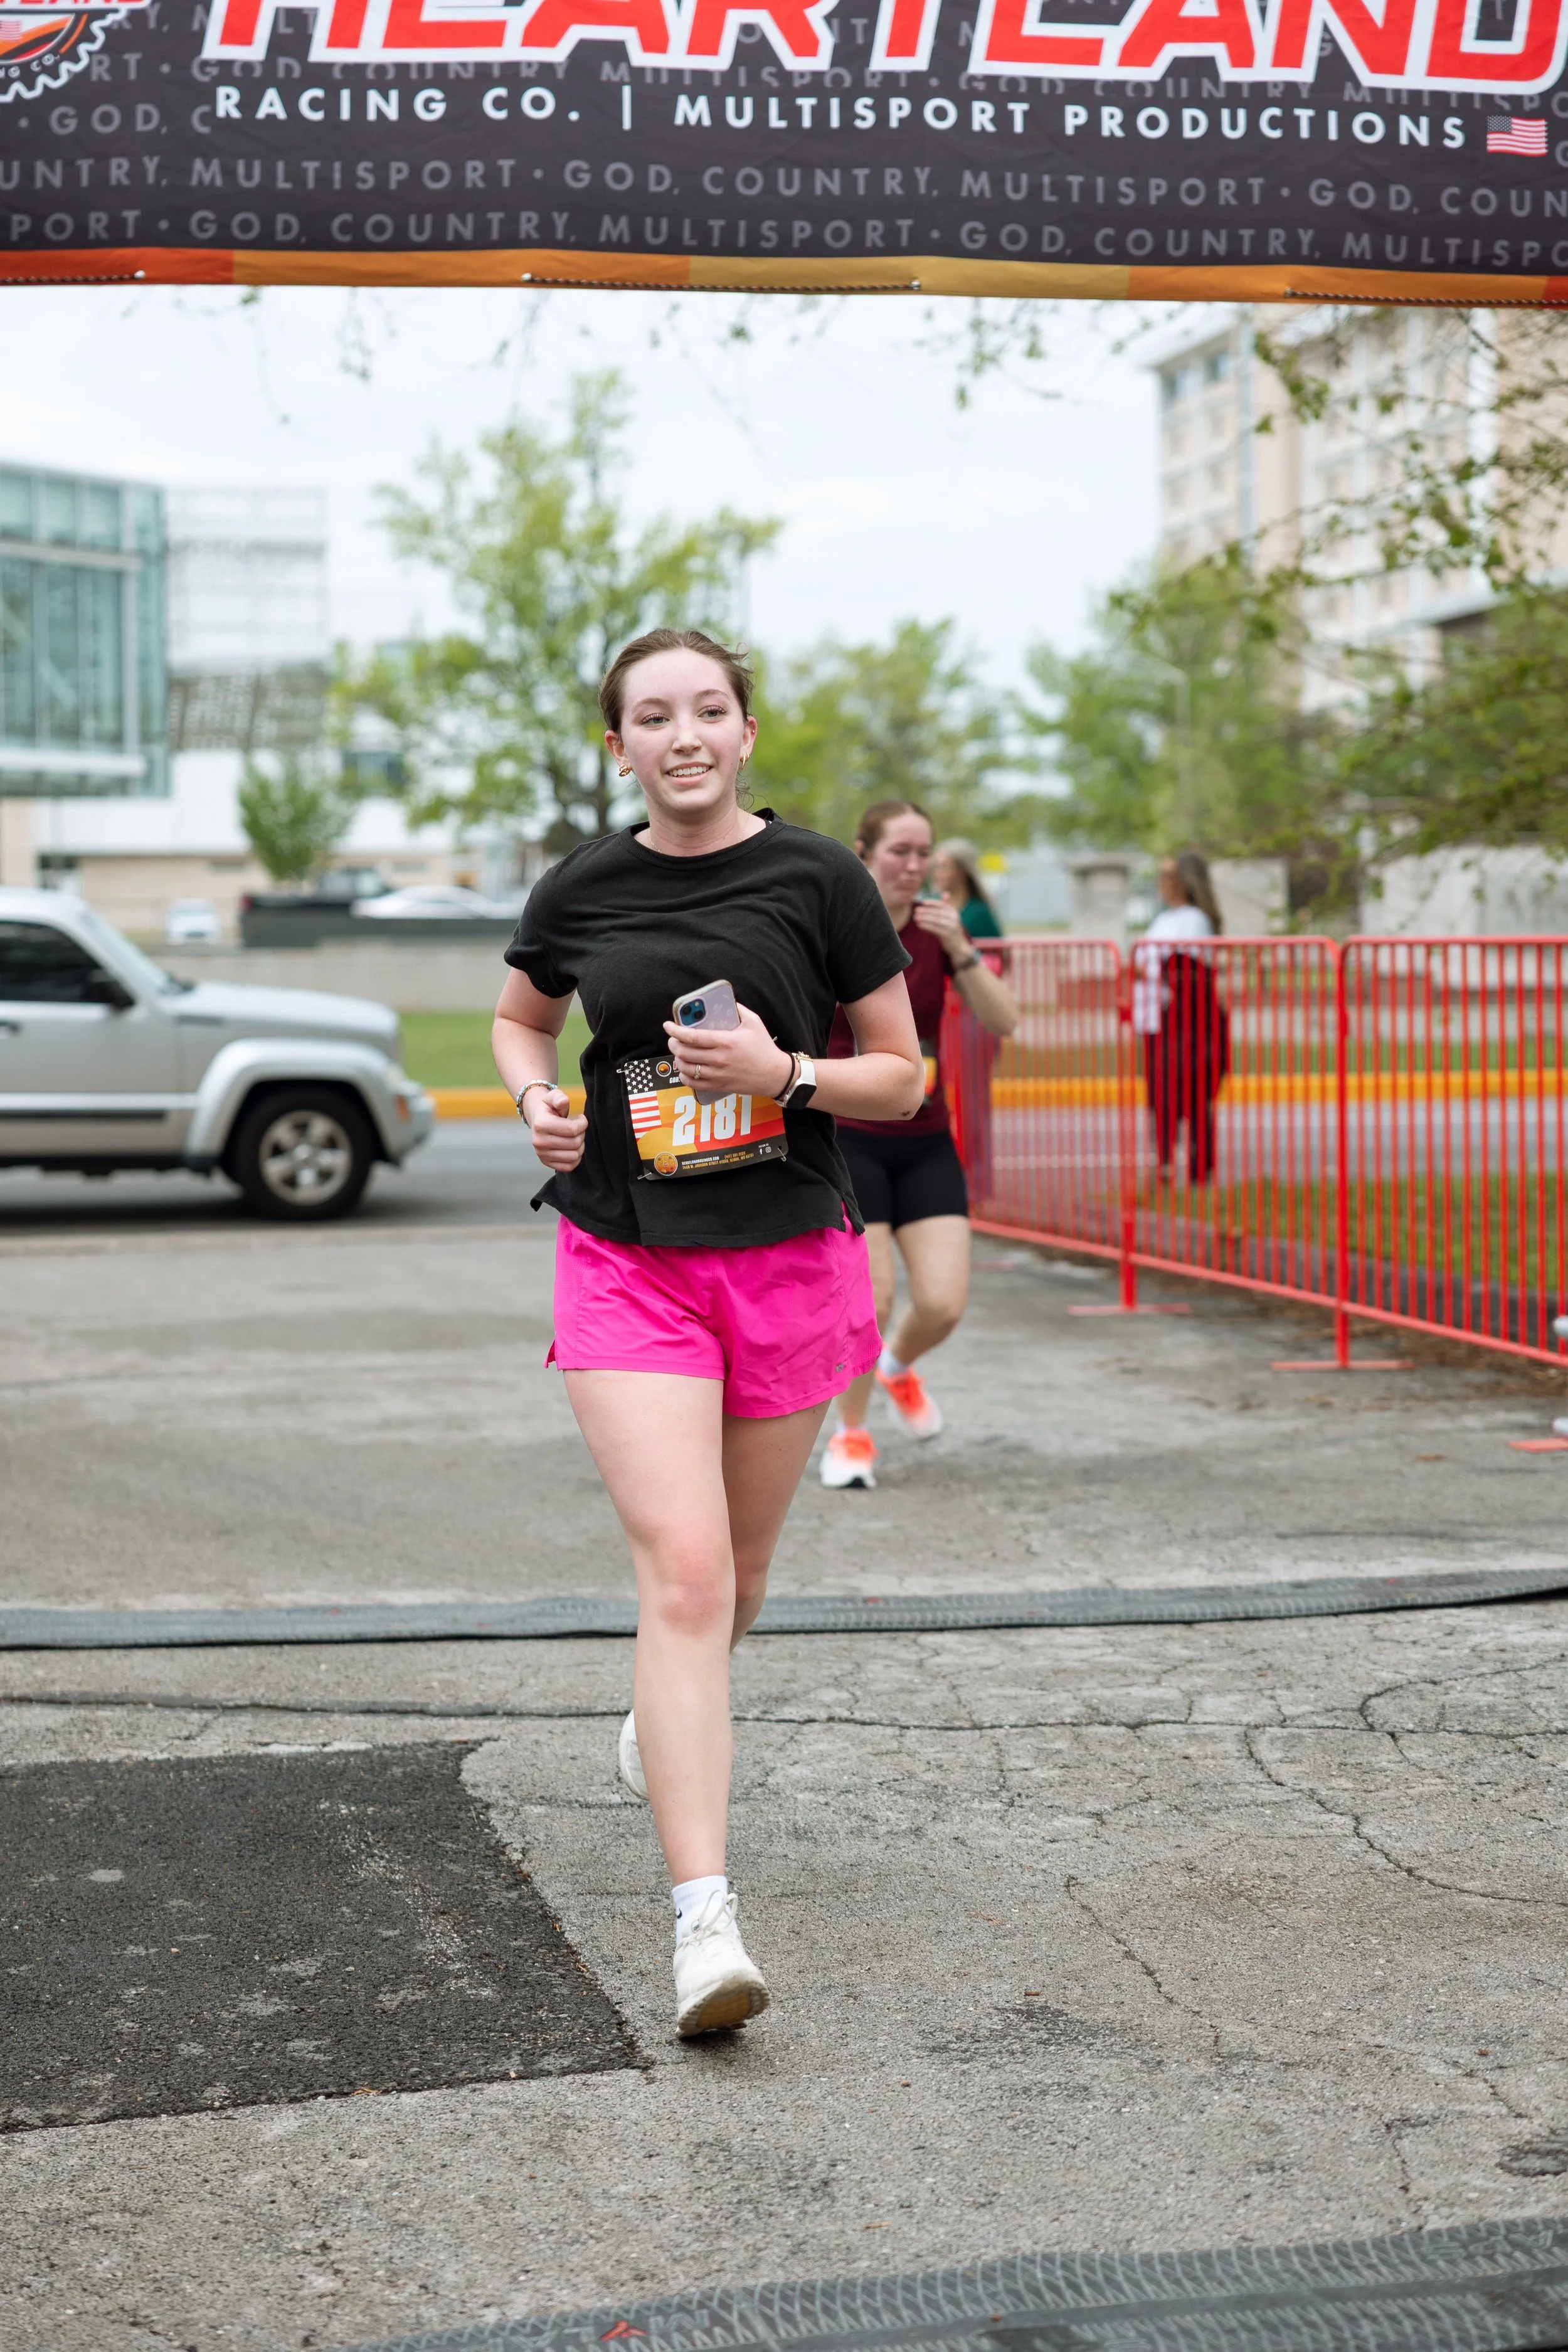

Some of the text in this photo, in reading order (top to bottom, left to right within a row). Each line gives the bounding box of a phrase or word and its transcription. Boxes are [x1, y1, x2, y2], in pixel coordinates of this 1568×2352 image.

[49, 103, 168, 135] GOD,
[215, 85, 448, 122] RACING
[482, 87, 580, 121] CO.
[674, 94, 1030, 134] MULTISPORT
[1064, 104, 1466, 149] PRODUCTIONS
[190, 157, 516, 191] MULTISPORT
[564, 159, 680, 196] GOD,
[702, 166, 940, 197] COUNTRY,
[960, 169, 1266, 206] MULTISPORT
[1308, 178, 1419, 215] GOD,
[189, 209, 306, 244] GOD,
[331, 211, 576, 243] COUNTRY,
[599, 215, 913, 248] MULTISPORT
[960, 221, 1072, 256] GOD,
[1094, 228, 1321, 258] COUNTRY,
[672, 1093, 752, 1147] 2181
